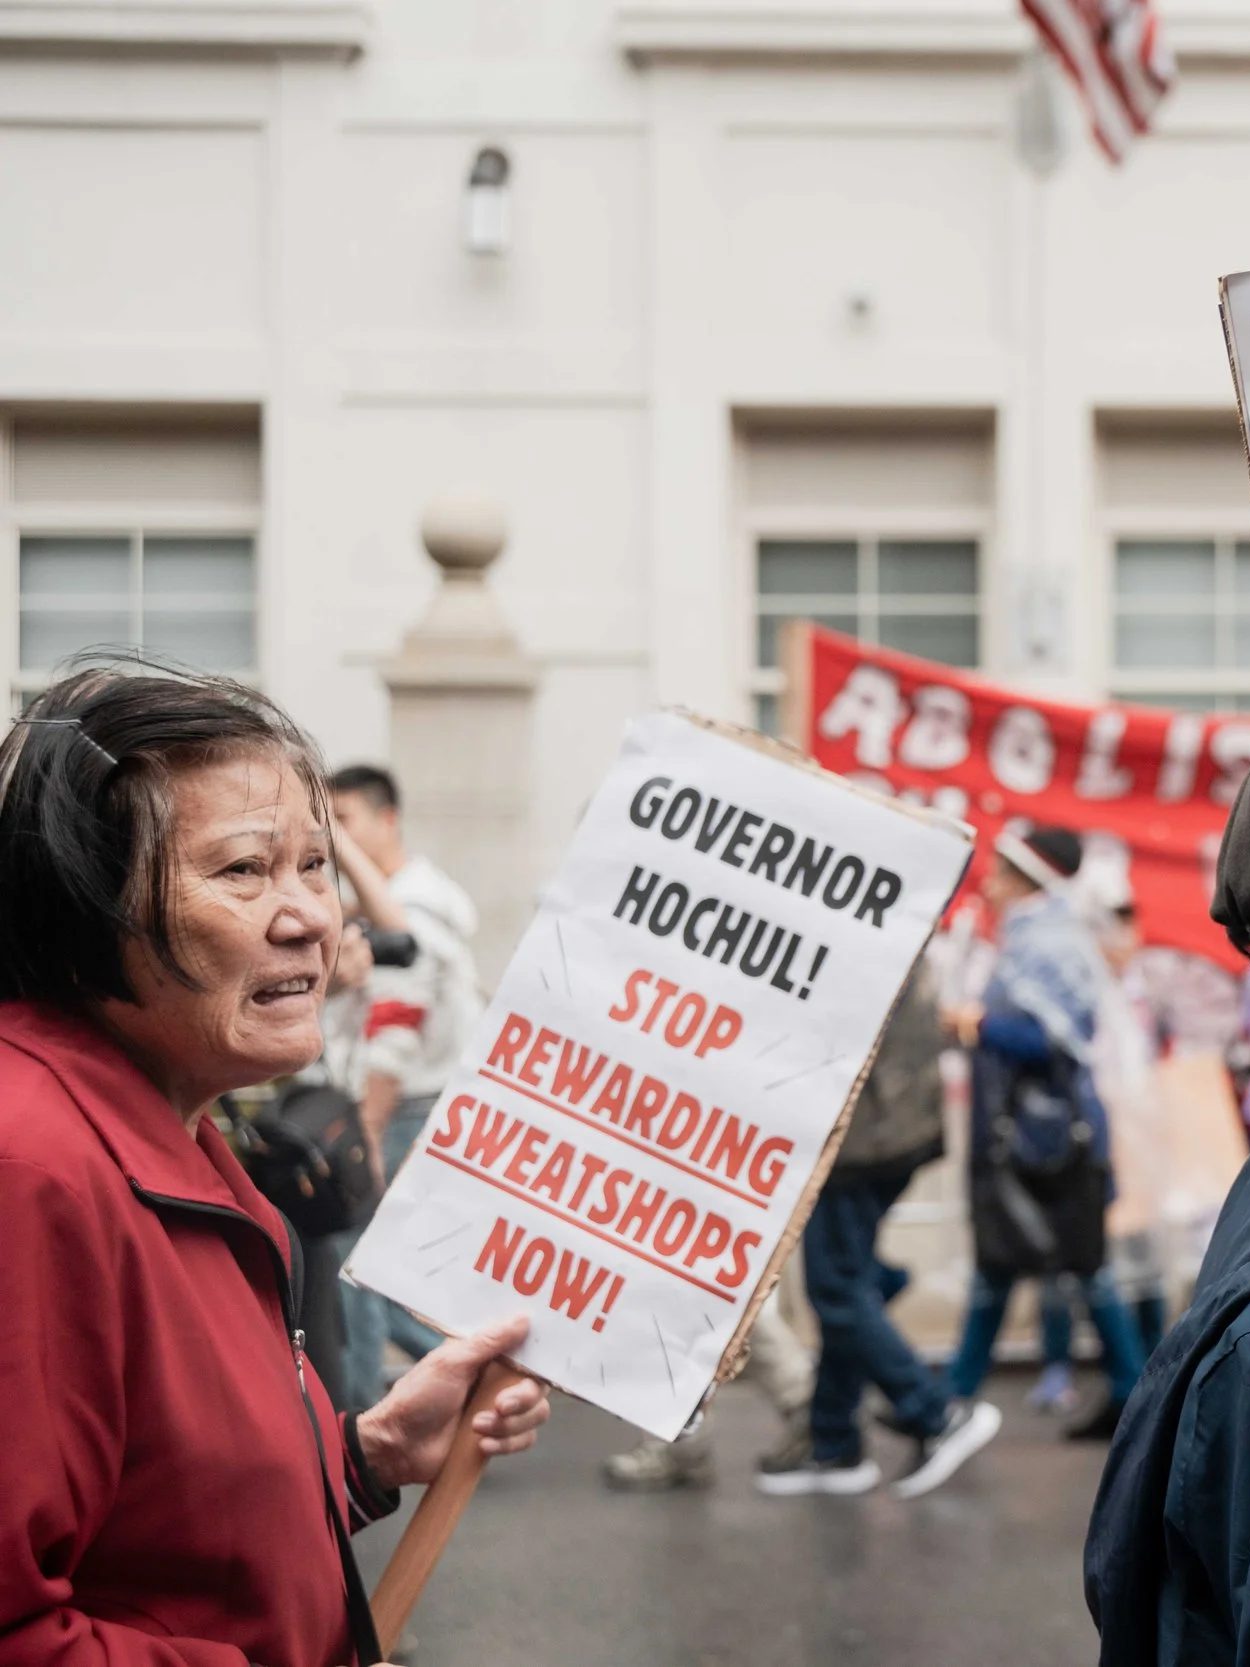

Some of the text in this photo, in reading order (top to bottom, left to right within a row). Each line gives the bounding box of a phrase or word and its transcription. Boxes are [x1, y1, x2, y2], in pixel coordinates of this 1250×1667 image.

[629, 776, 904, 928] GOVERNOR
[612, 866, 829, 1001] HOCHUL!
[608, 968, 743, 1060] STOP
[487, 1012, 794, 1197] REWARDING
[432, 1094, 761, 1289] SWEATSHOPS
[473, 1216, 625, 1334] NOW!
